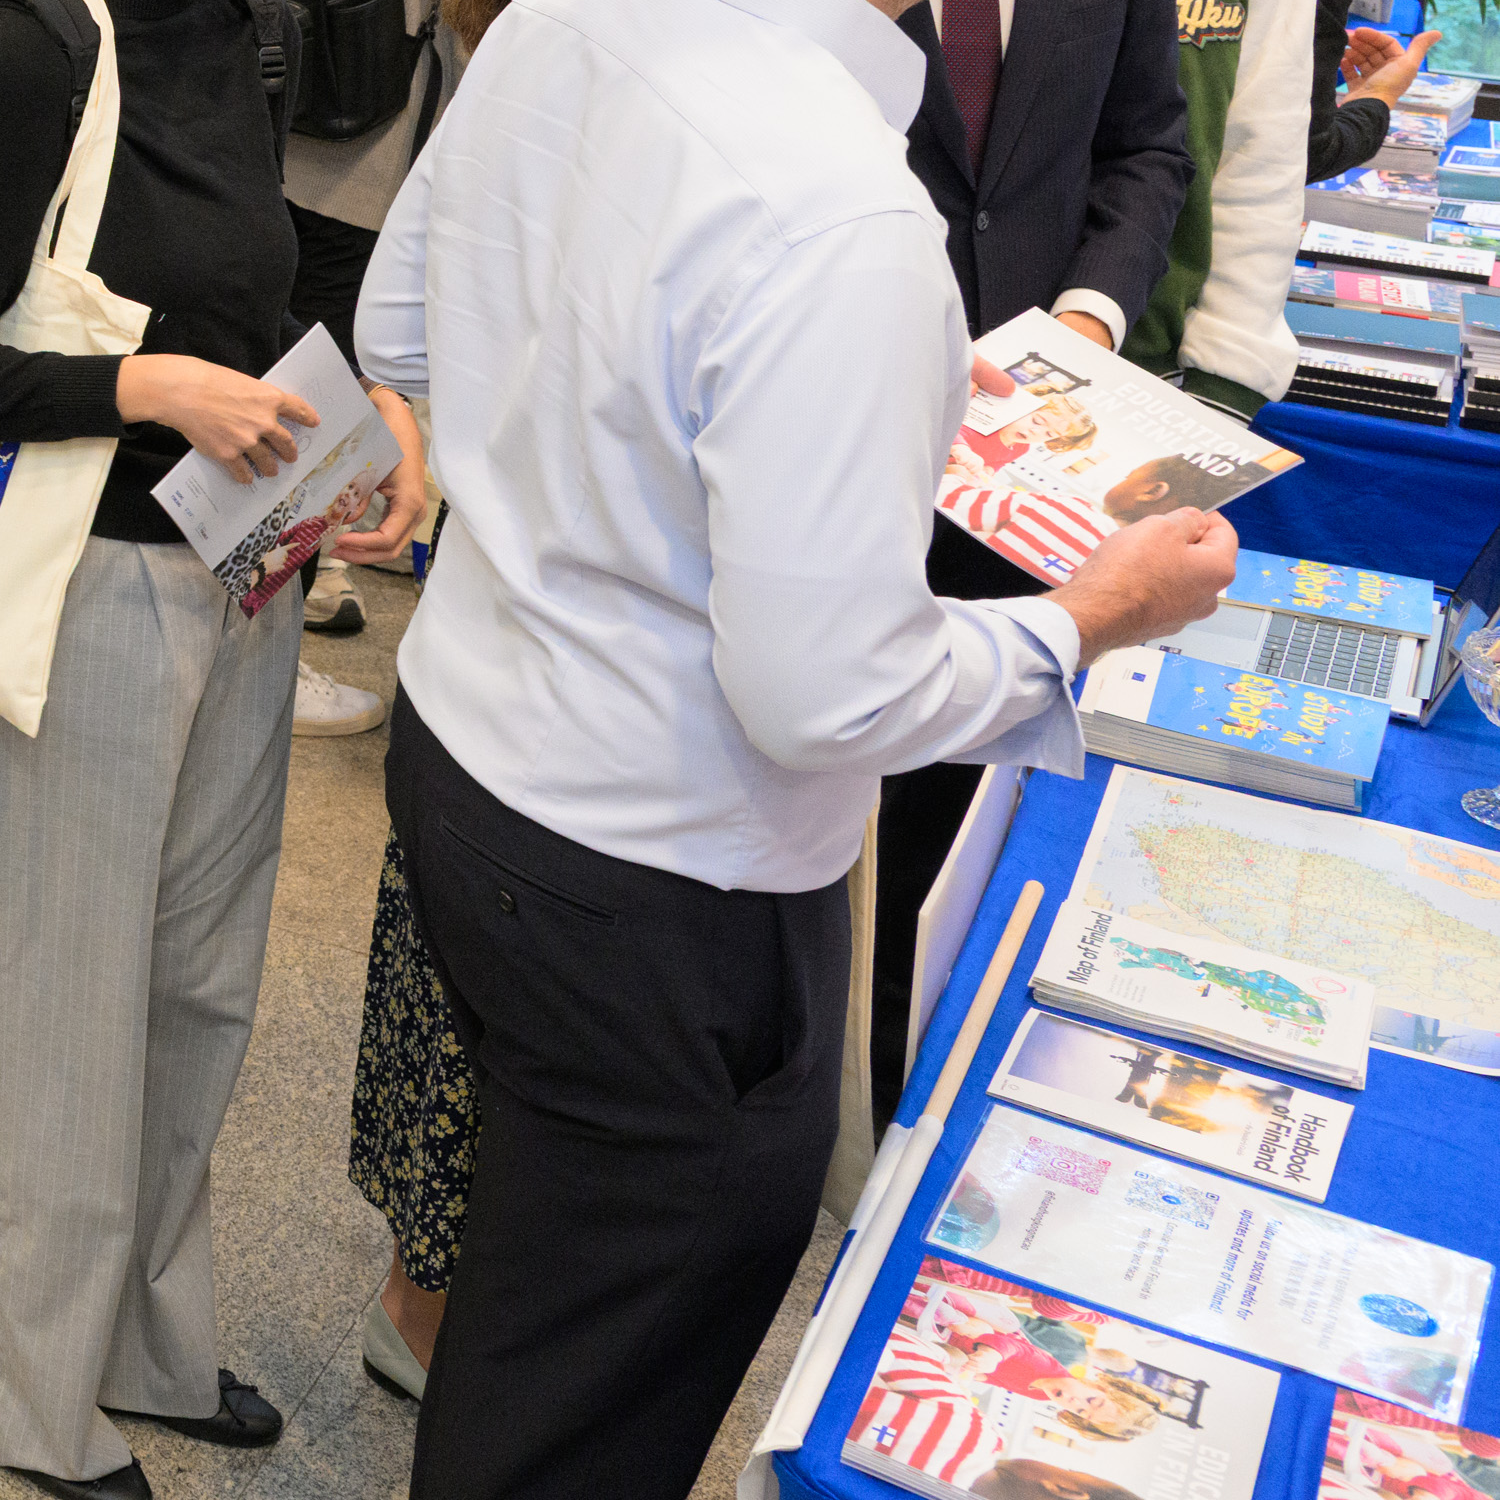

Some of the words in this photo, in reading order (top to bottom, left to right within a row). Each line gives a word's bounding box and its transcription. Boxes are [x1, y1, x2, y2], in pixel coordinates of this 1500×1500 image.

[1087, 388, 1123, 414] IN
[1124, 410, 1236, 477] FINLAND
[1113, 381, 1257, 467] EDUCATION
[1292, 558, 1331, 609] EUROPE
[1356, 571, 1384, 606] STUDY
[1221, 673, 1275, 739] EUROPE
[1297, 691, 1329, 737] STUDY
[1083, 910, 1113, 948] Finland
[1077, 941, 1099, 961] of
[1066, 957, 1101, 985] Map
[1271, 1103, 1290, 1125] of
[1252, 1125, 1292, 1177] Finland
[1283, 1112, 1328, 1184] Handbook
[1235, 1208, 1254, 1238] updates
[1226, 1253, 1239, 1270] more
[1230, 1236, 1244, 1253] and
[1249, 1260, 1265, 1287] social
[1242, 1282, 1258, 1307] media
